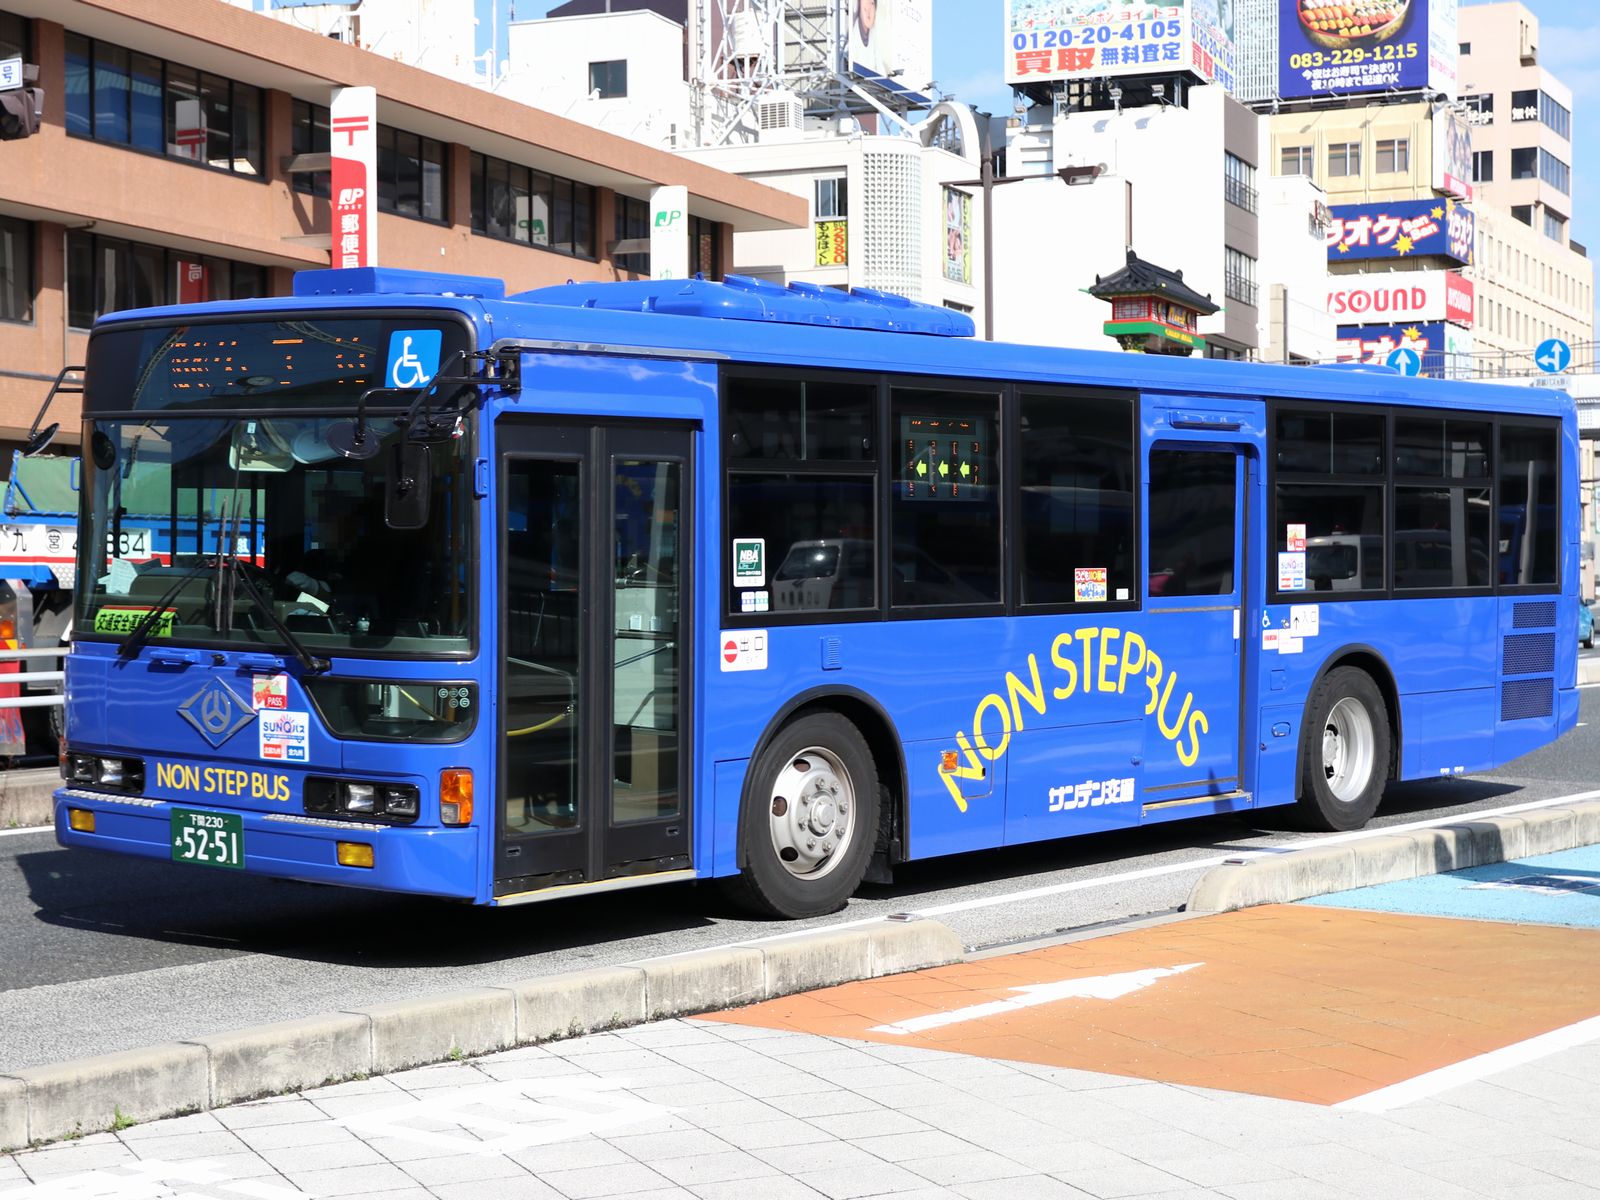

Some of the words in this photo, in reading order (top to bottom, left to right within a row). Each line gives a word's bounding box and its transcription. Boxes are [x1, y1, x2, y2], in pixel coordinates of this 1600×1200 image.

[1013, 20, 1181, 50] 0120-20-4105
[1015, 48, 1096, 76] 買取
[1101, 42, 1181, 66] 無料査定
[1290, 43, 1418, 69] 083-229-1215
[267, 697, 283, 706] PASS
[938, 653, 1046, 812] NON
[1051, 627, 1146, 700] STEP
[1145, 649, 1208, 767] BUS
[157, 763, 199, 792] NON
[204, 768, 248, 796] STEP
[252, 774, 290, 801] BUS
[1049, 778, 1136, 812] サンデン交通
